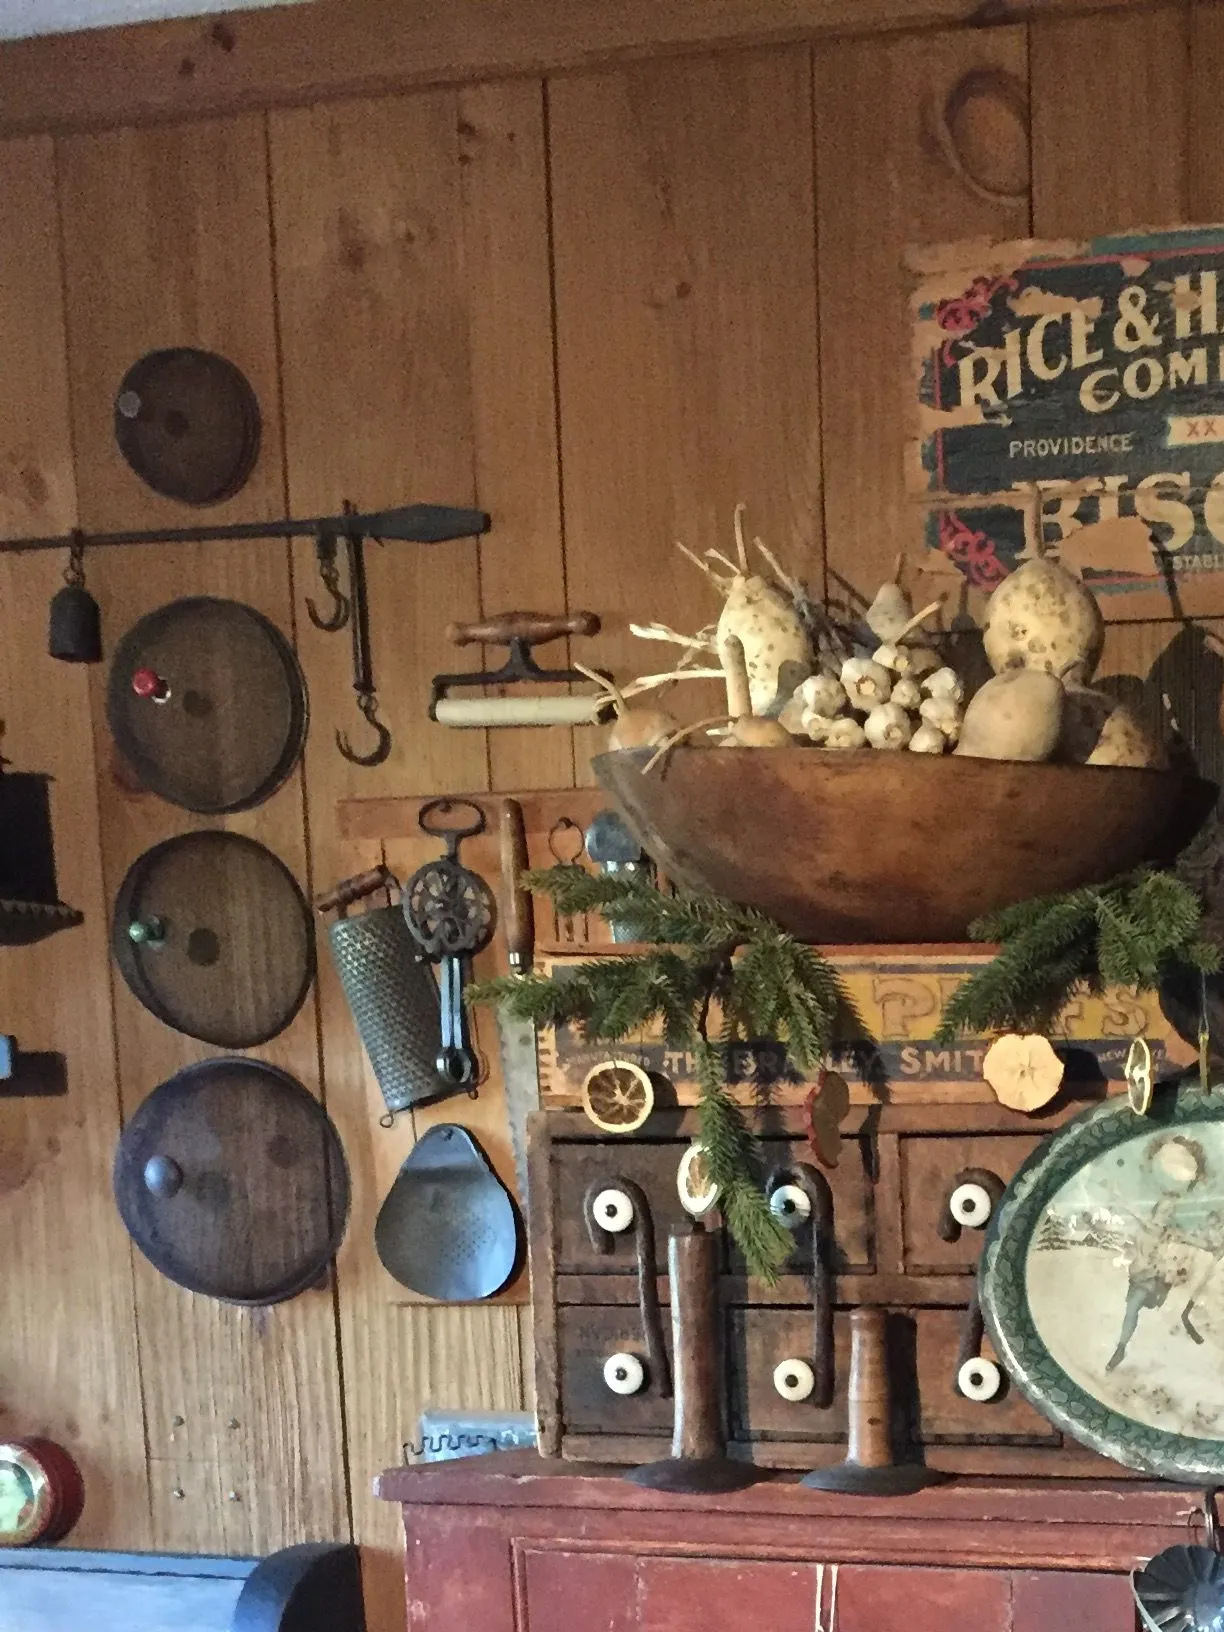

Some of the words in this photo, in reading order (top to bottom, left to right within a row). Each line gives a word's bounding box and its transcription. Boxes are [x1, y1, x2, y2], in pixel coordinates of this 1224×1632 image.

[958, 298, 1103, 425] RICE
[1113, 285, 1162, 352] &
[1009, 432, 1133, 459] PROVIDENCE
[1186, 420, 1217, 438] XX
[901, 1046, 984, 1075] SMIT
